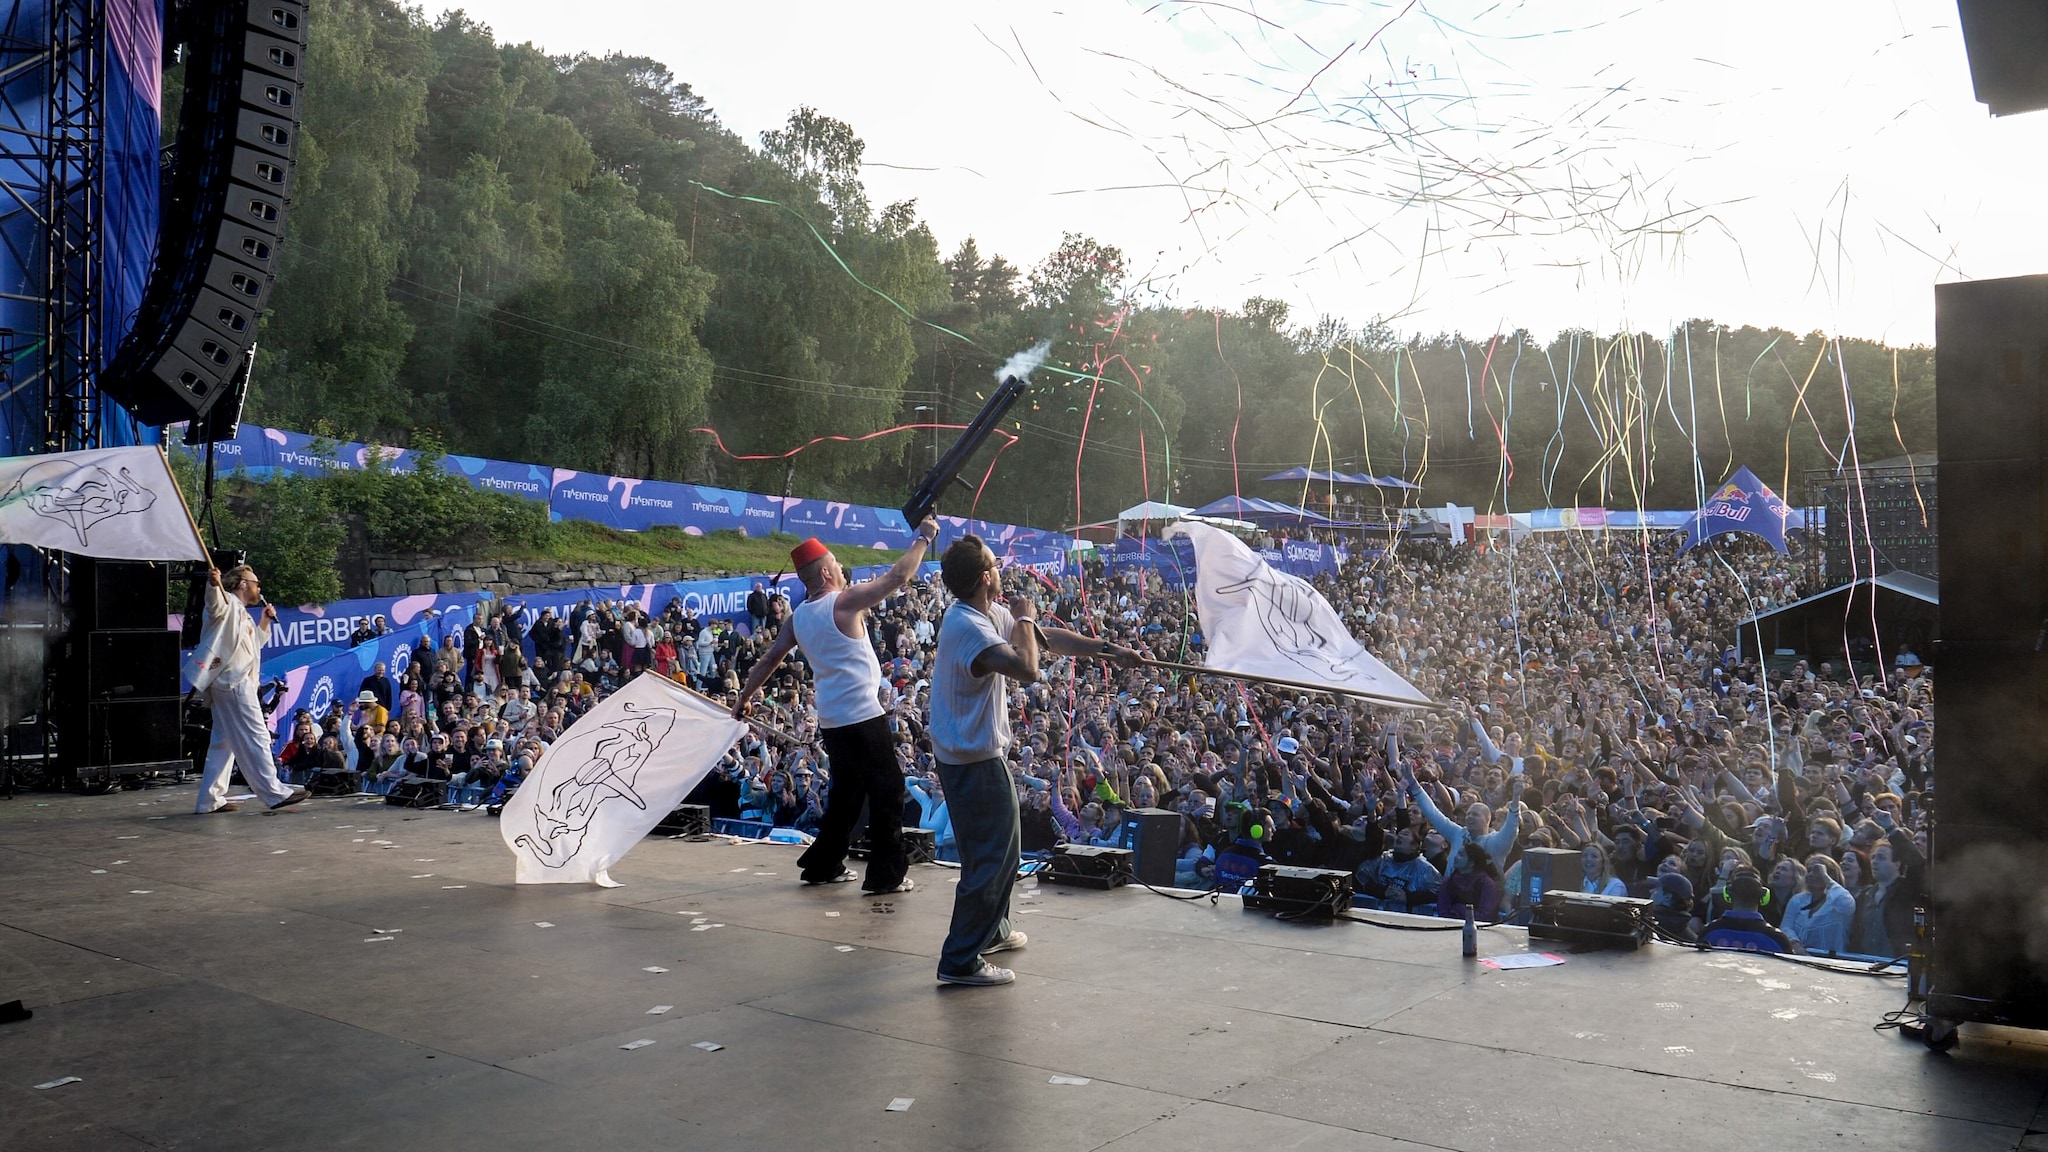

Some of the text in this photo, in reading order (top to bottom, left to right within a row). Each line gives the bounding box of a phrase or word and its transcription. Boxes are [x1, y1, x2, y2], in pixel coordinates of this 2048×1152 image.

[480, 476, 538, 493] TWENTYFOUR
[562, 488, 609, 503] TWENTYFOUR
[630, 495, 673, 509] TWENTYFOUR
[692, 502, 730, 514] TWENTYFOUR
[745, 507, 775, 519] TWENTYFOUR
[1715, 502, 1751, 521] Bull
[1637, 515, 1655, 523] AR
